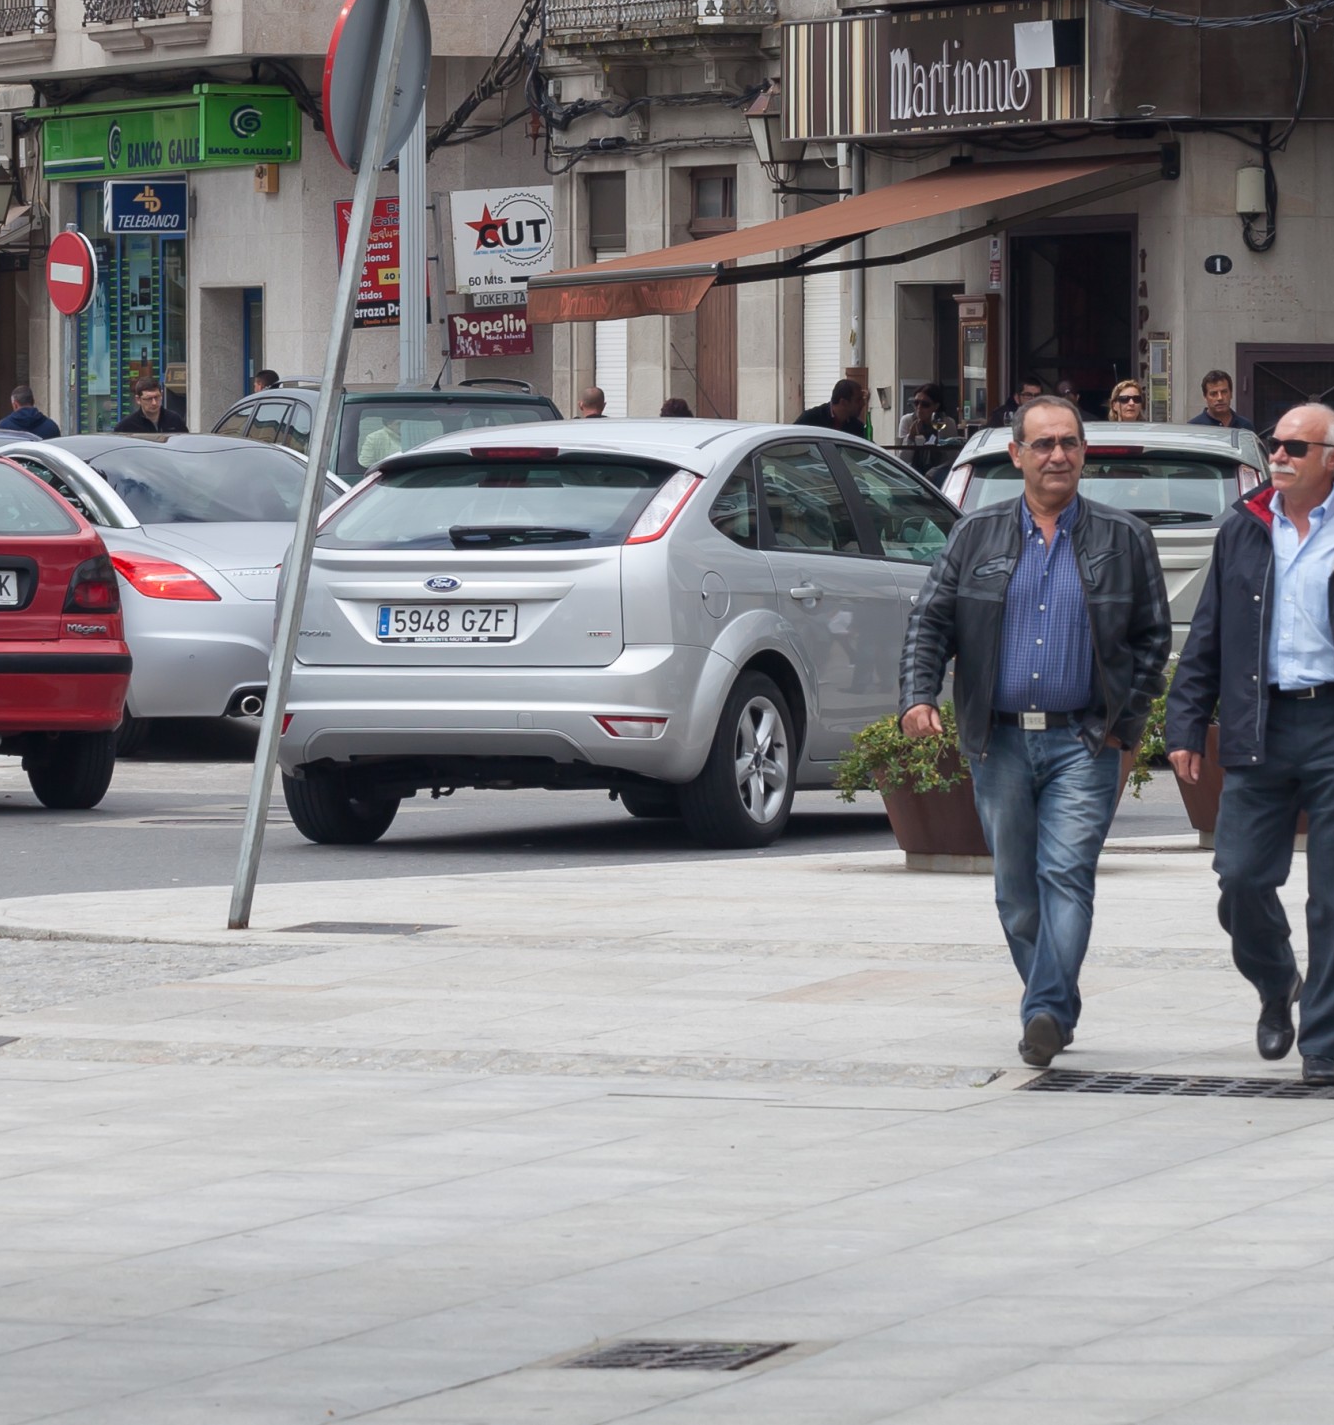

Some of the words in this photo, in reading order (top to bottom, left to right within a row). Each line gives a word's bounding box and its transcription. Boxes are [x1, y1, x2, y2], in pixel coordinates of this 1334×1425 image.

[128, 139, 162, 168] BANCO
[169, 137, 199, 164] GALLE
[208, 147, 239, 155] BANCO
[118, 214, 180, 228] TELEBANCO
[479, 219, 546, 248] CUT
[1216, 258, 1222, 271] 1
[469, 277, 481, 286] 60
[484, 276, 506, 284] Mts.
[476, 293, 508, 305] JOKER
[355, 307, 385, 318] erraza
[394, 609, 450, 632] 5948
[462, 609, 508, 632] GZF
